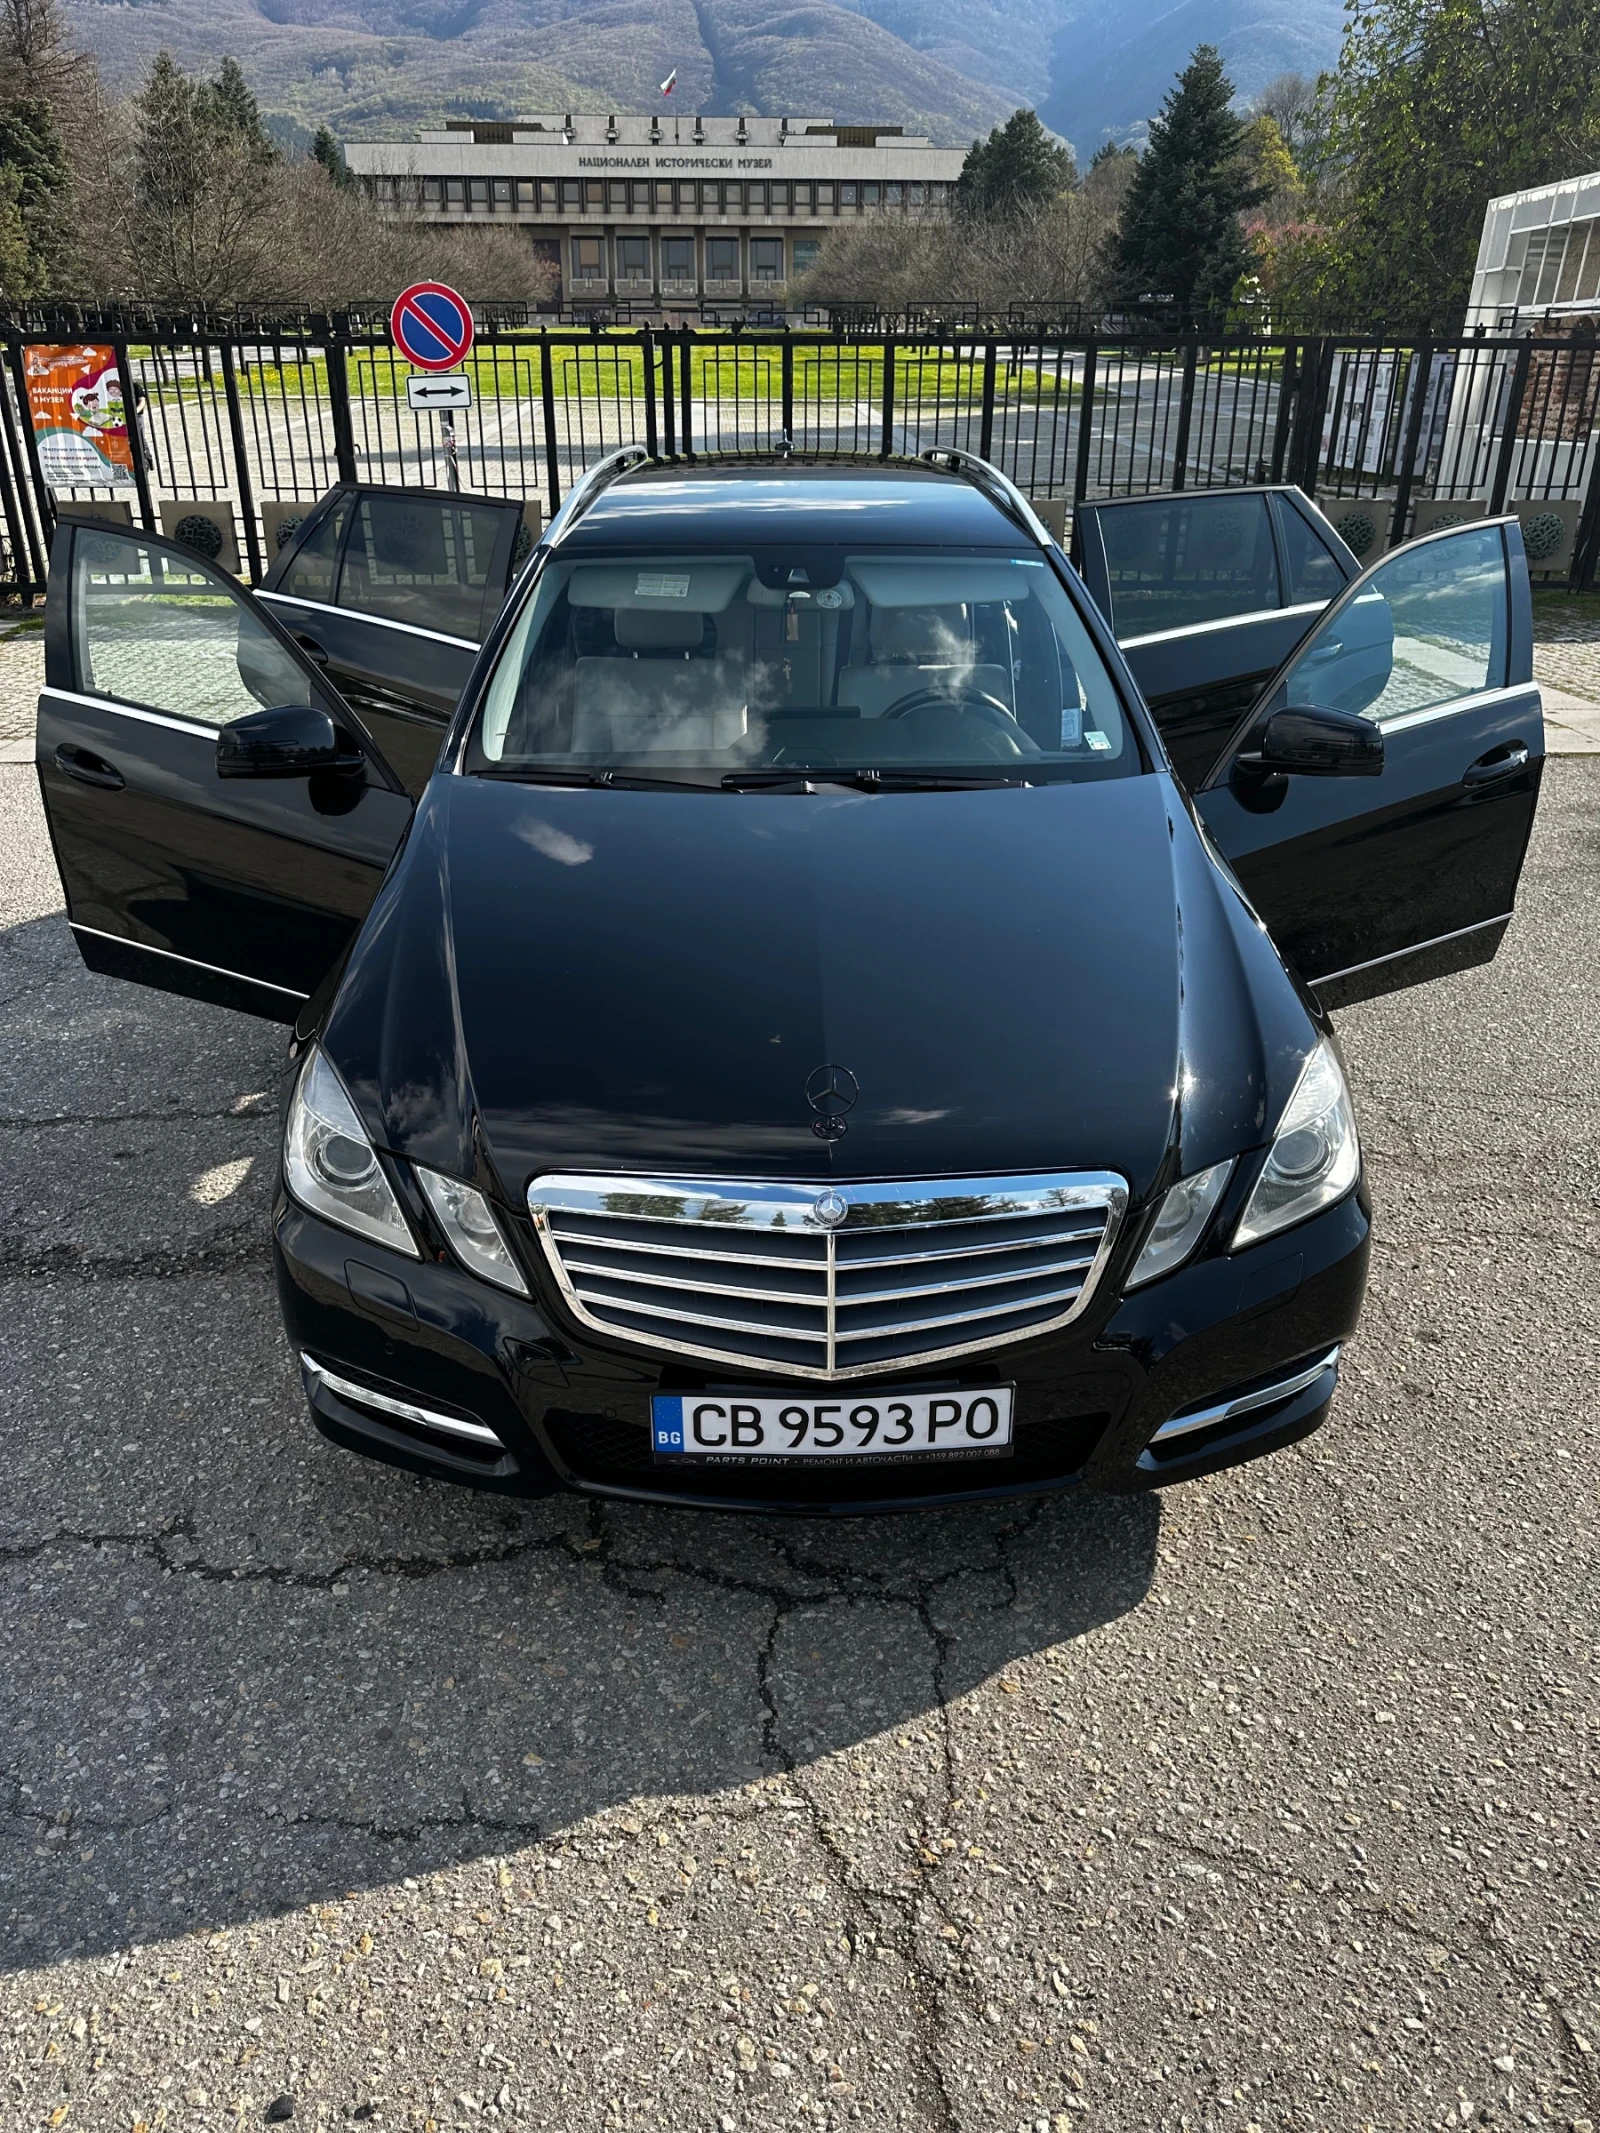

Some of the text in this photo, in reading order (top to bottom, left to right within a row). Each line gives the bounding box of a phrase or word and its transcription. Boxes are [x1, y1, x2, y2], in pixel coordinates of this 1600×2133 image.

[578, 157, 773, 169] НАЦИОНАЛЕН ИСТОРИЧЕСКИ МУЗЕЙ
[32, 387, 73, 395] ВАКАНЦИИ
[658, 1396, 999, 1448] BG CB 9593 PO
[706, 1456, 746, 1464] PARTS
[750, 1457, 790, 1465] POINT
[803, 1457, 844, 1466] РЕМОНТ
[845, 1457, 854, 1465] И
[855, 1455, 913, 1465] АВТОЧАСТИ
[925, 1452, 946, 1461] +359
[966, 1450, 983, 1458] 007
